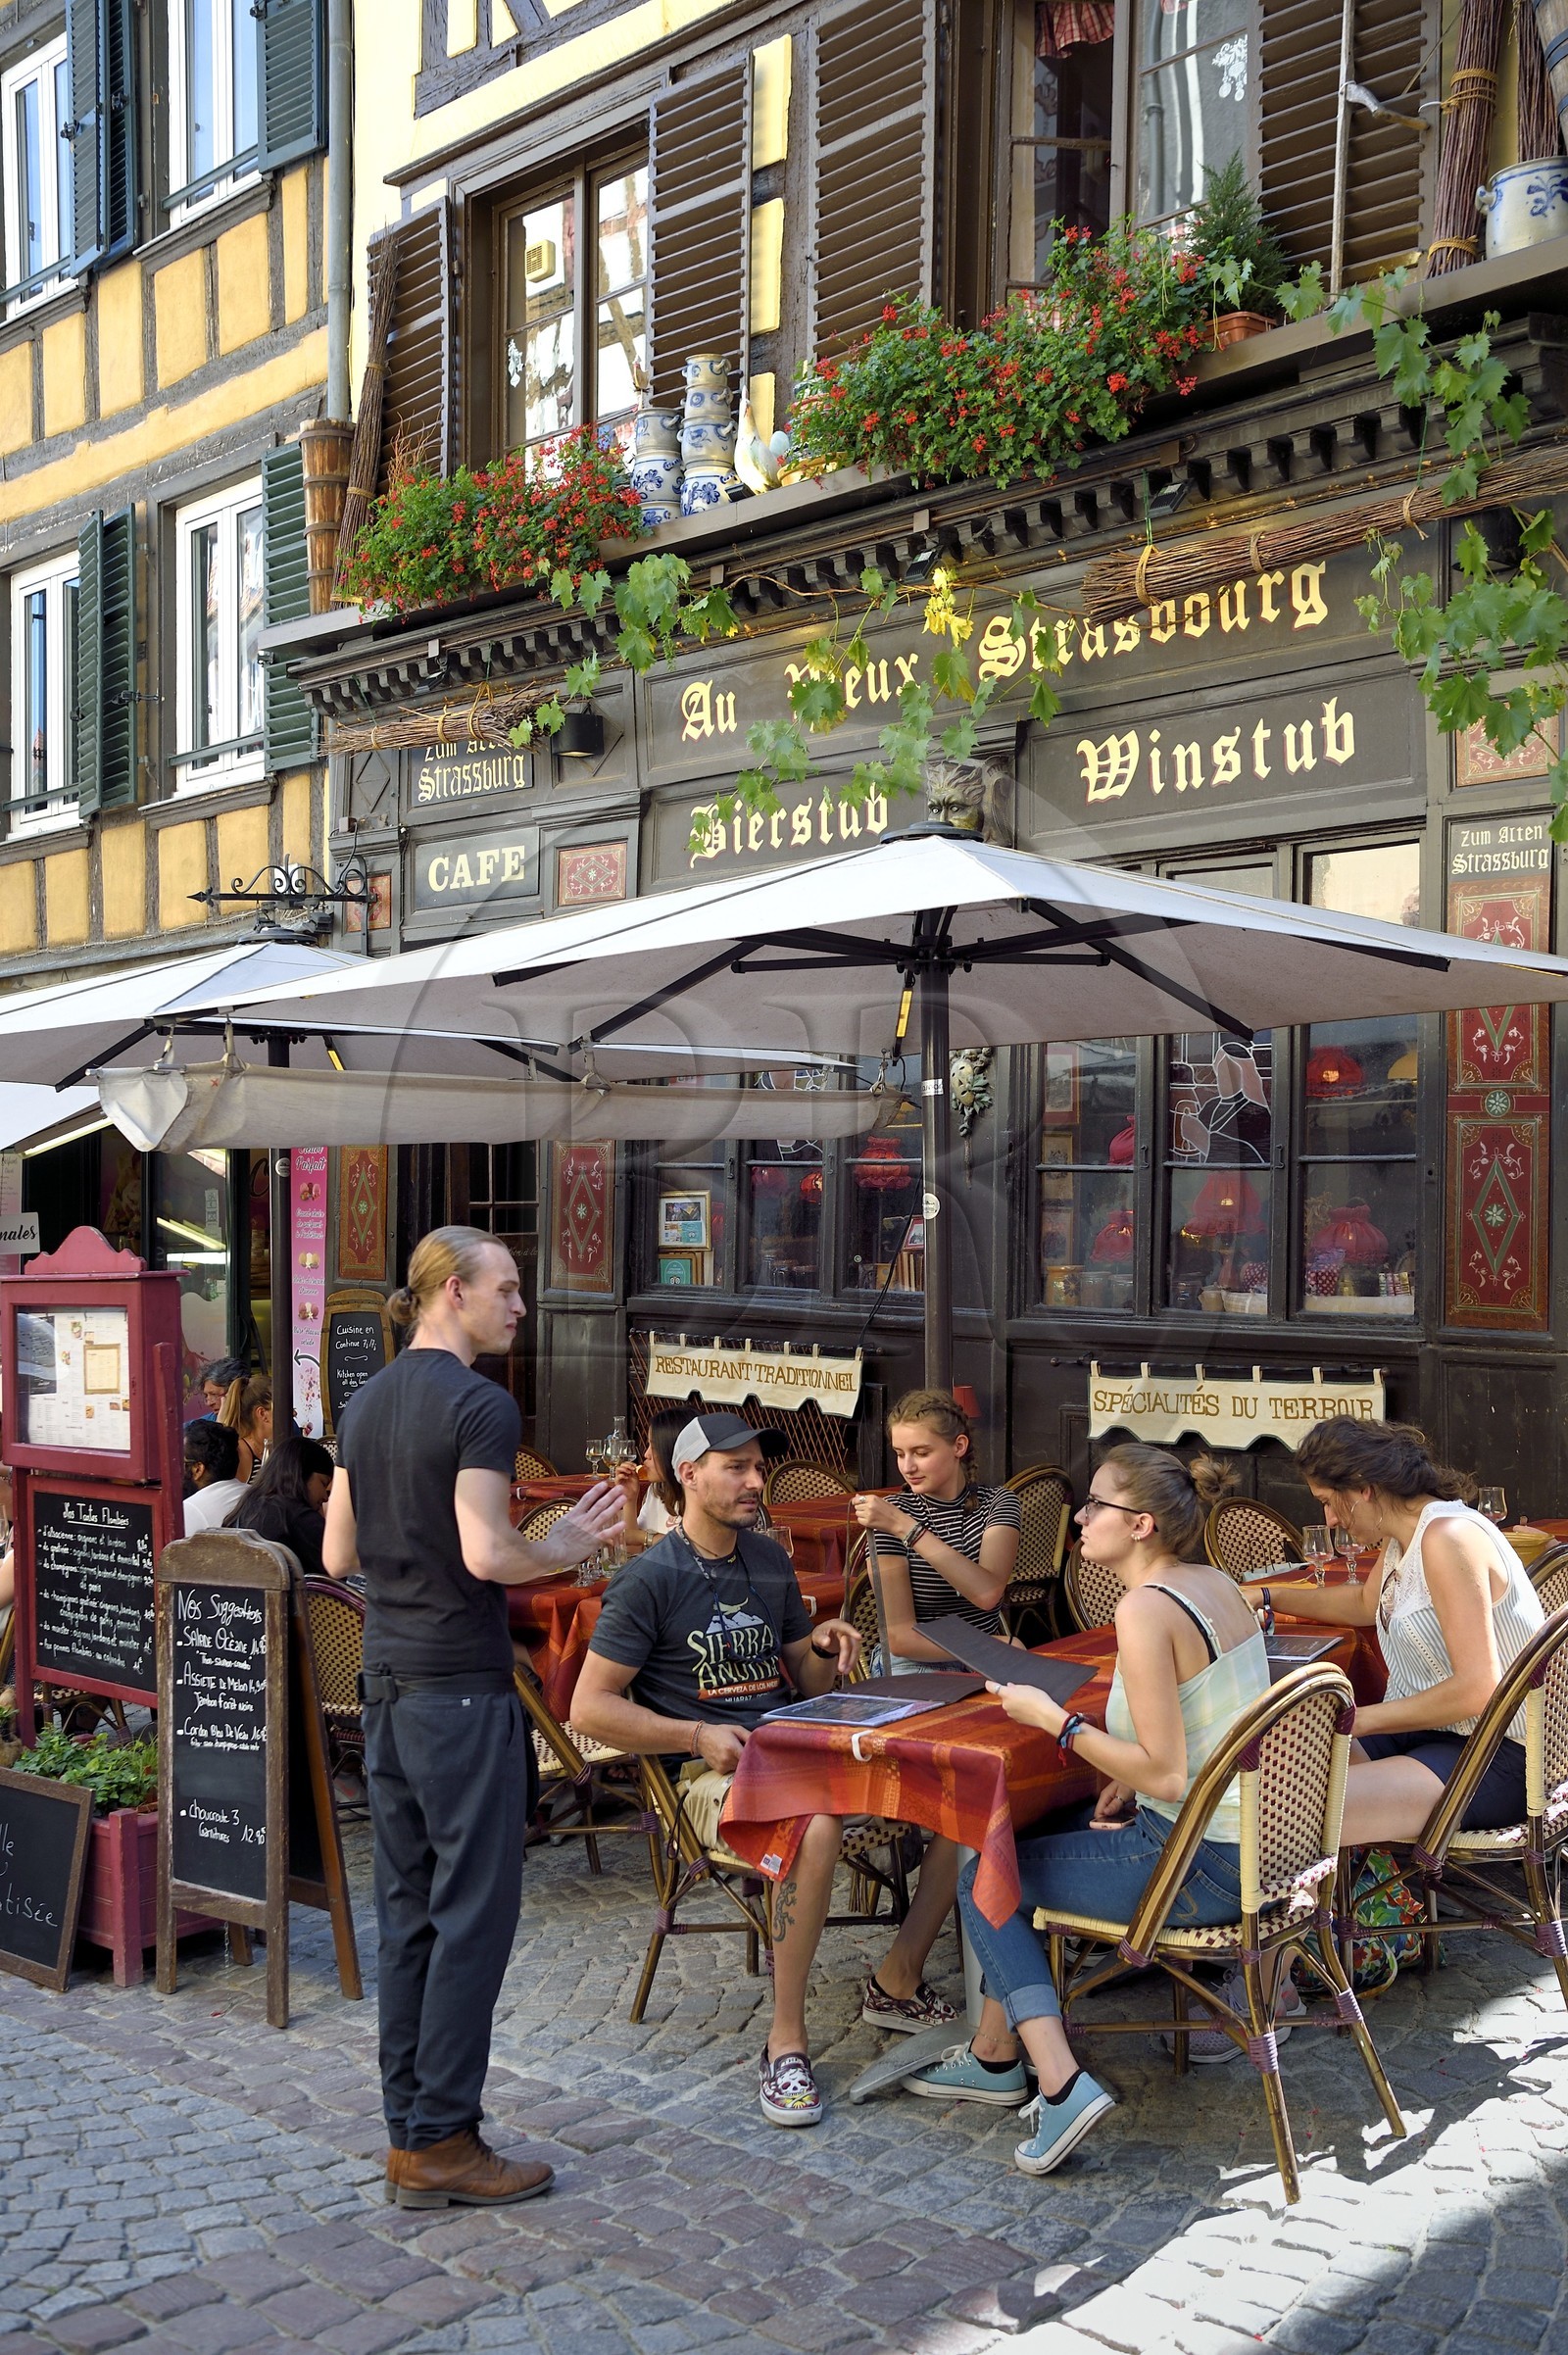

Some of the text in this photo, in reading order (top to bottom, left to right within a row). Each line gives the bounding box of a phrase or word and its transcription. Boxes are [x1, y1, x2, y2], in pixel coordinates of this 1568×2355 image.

[682, 678, 738, 742] Au
[784, 653, 919, 733] eux
[1077, 697, 1356, 805] Winstub
[417, 754, 526, 803] Strassburg
[689, 782, 889, 868] Bierstub
[1460, 830, 1491, 847] Zum
[428, 845, 526, 892] CAFE
[1451, 848, 1549, 875] Strassburg
[335, 1338, 360, 1349] Continue
[336, 1324, 364, 1335] Cuisine
[336, 1368, 368, 1381] Kitchen open
[655, 1355, 858, 1392] RESTAURANT TRADITIONNEL
[1094, 1384, 1374, 1420] SPÉCIALITÉS DU TERROIR
[178, 1589, 202, 1621] Nos
[207, 1594, 263, 1627] Suggestions
[718, 1685, 748, 1695] CERVEZA
[183, 1716, 208, 1739] Cordon
[231, 1809, 240, 1826] 3
